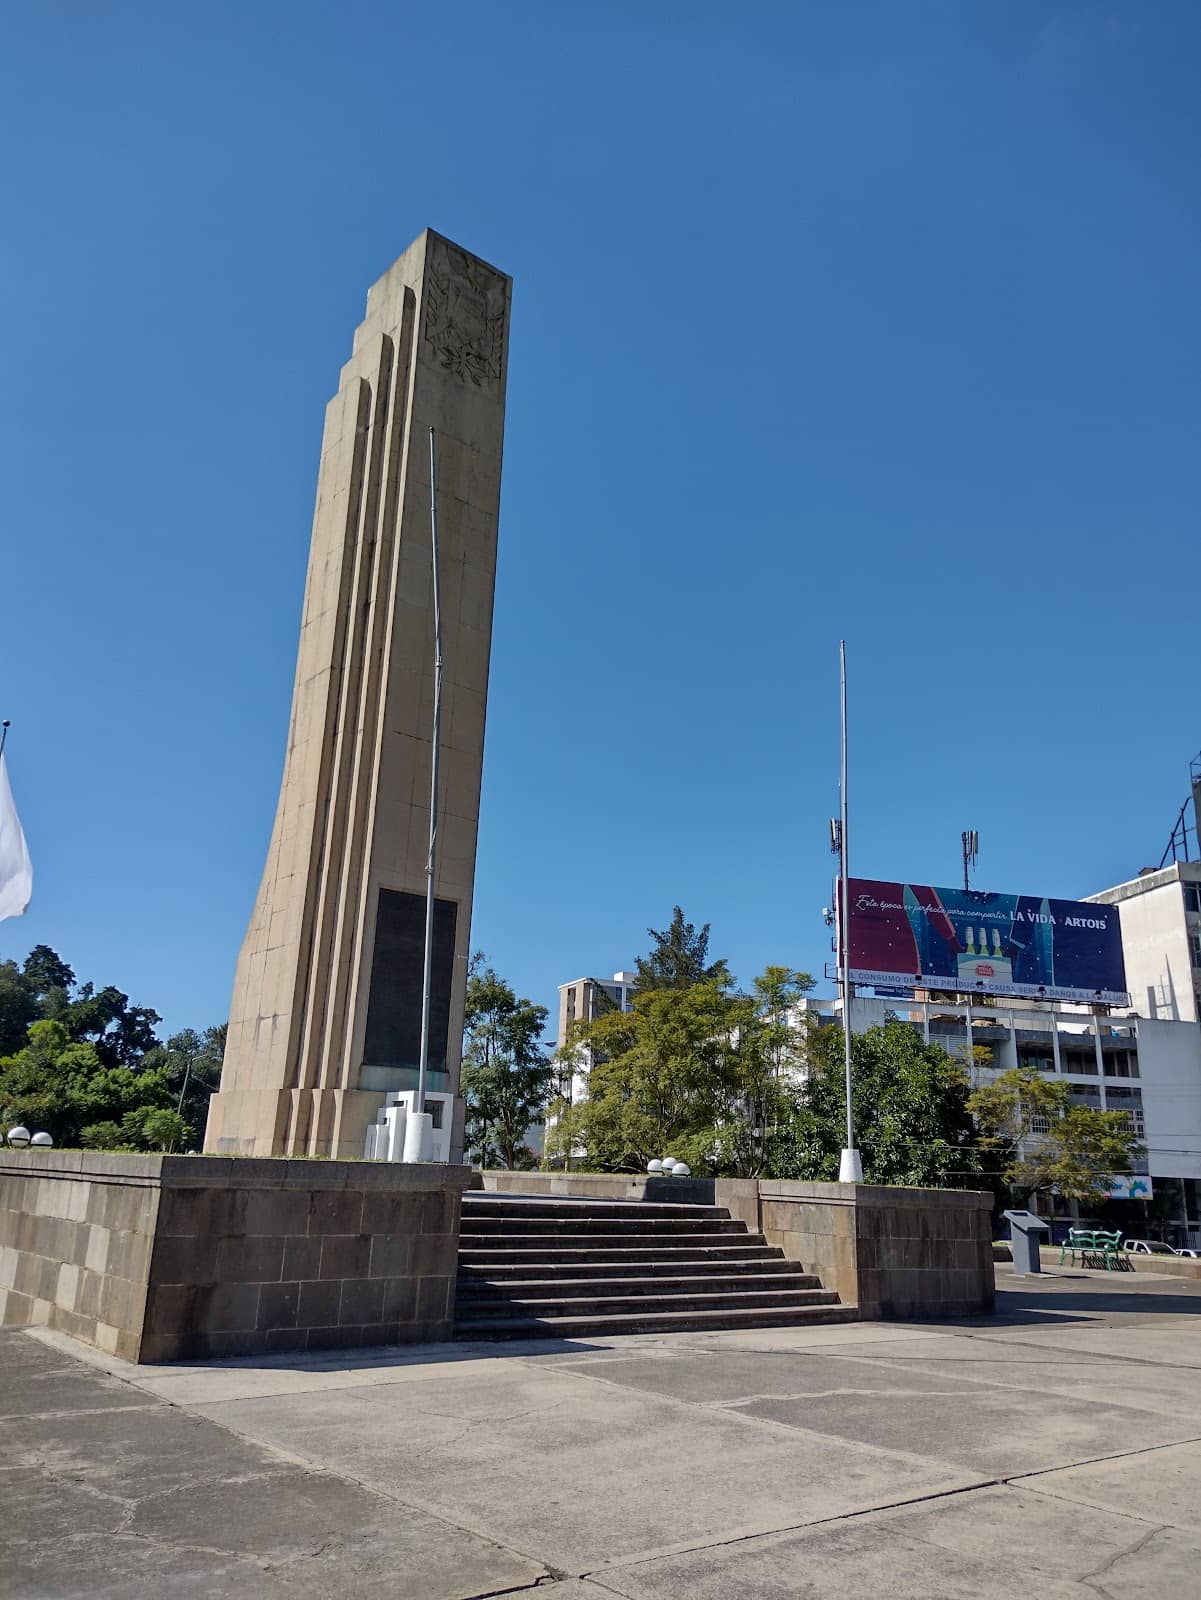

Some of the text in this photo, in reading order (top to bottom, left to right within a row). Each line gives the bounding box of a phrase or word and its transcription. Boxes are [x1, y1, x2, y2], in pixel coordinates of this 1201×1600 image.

[856, 894, 879, 911] Esta
[967, 910, 1008, 921] compartir
[1010, 911, 1025, 922] LA
[1027, 912, 1057, 925] VIDA
[1065, 916, 1107, 930] ARTOIS
[858, 972, 902, 984] CONSUMO
[941, 978, 986, 991] PRODUCO
[988, 984, 1016, 993] CAUSA
